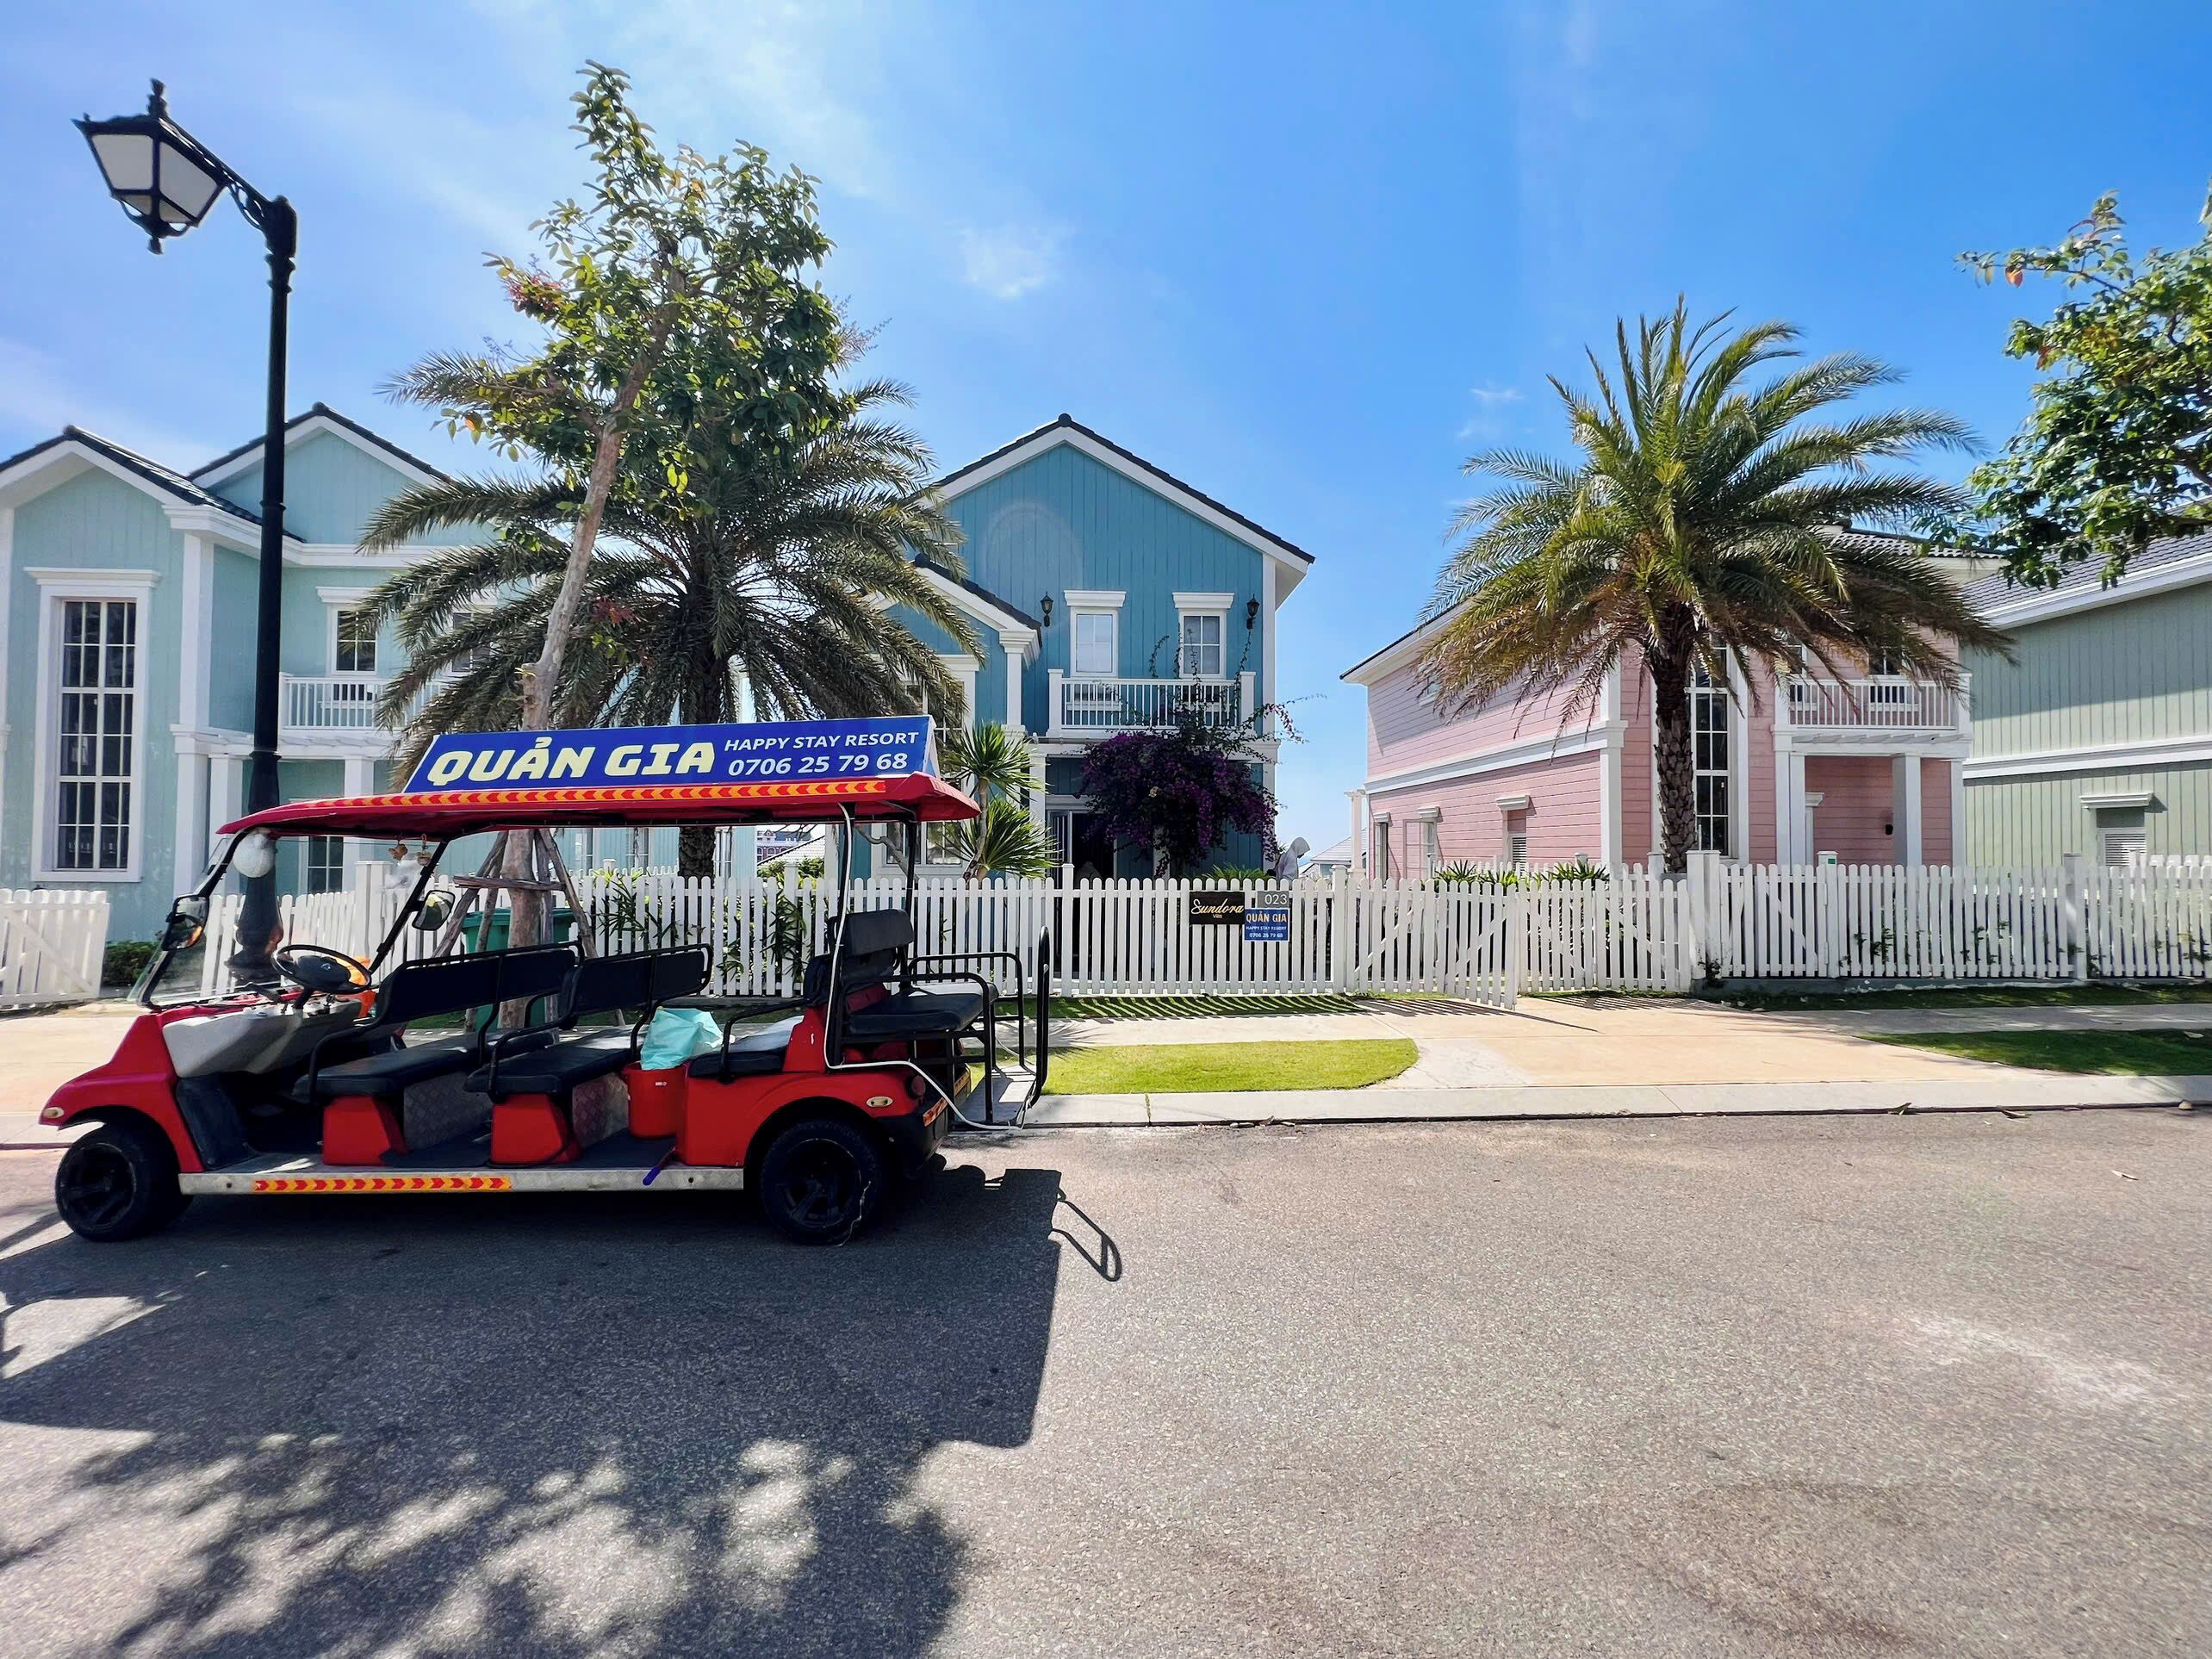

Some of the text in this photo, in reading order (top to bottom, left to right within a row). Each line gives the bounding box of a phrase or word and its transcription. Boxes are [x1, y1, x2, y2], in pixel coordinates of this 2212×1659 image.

[724, 731, 920, 752] HAPPY STAY RESORT
[427, 736, 715, 786] QUẢN GIA
[728, 753, 908, 776] 0706 25 79 68
[1190, 898, 1244, 914] Sundora
[1264, 894, 1287, 904] 023
[1246, 910, 1287, 923] QUẢN GIA
